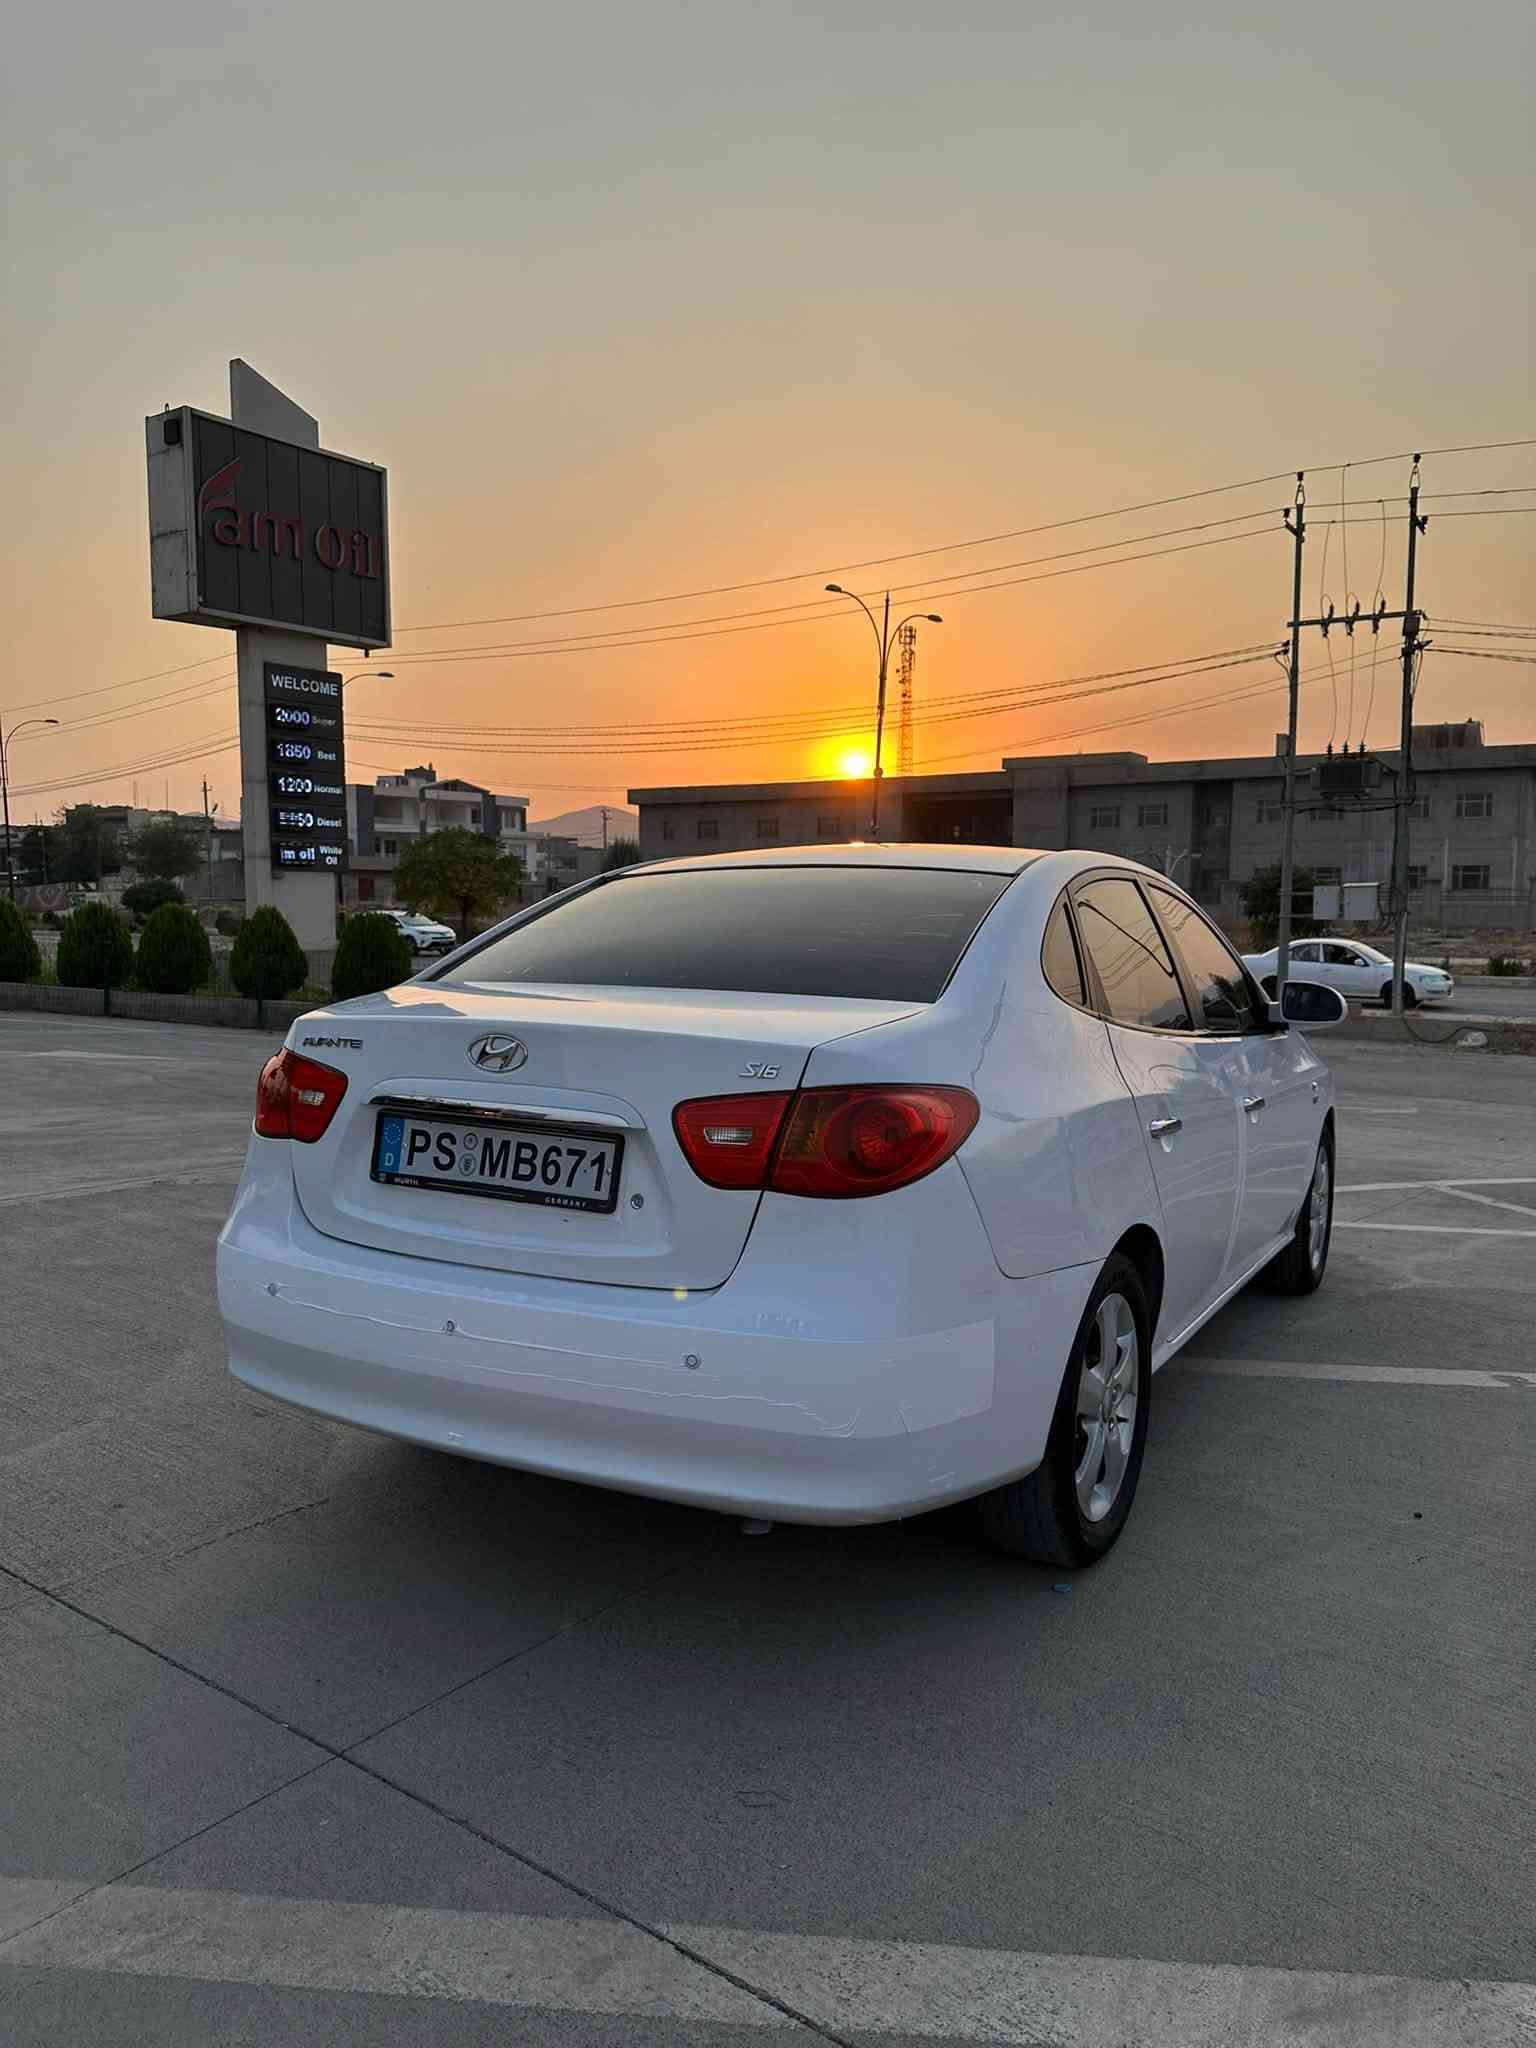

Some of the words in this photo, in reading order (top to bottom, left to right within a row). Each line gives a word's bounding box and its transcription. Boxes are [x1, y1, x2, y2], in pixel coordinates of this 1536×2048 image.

[271, 674, 339, 696] WELCOME
[275, 707, 310, 726] 2000
[276, 743, 312, 760] 1850
[317, 750, 337, 761] Best
[277, 776, 313, 793] 1200
[314, 785, 344, 795] Normal
[316, 817, 343, 828] Diesel
[319, 845, 343, 855] White
[325, 855, 338, 866] Oil
[302, 1037, 364, 1049] AVANTE
[738, 1061, 781, 1080] S16
[383, 1152, 394, 1166] D
[406, 1128, 458, 1171] PS
[478, 1136, 606, 1192] MB671
[544, 1196, 588, 1209] GERMANY
